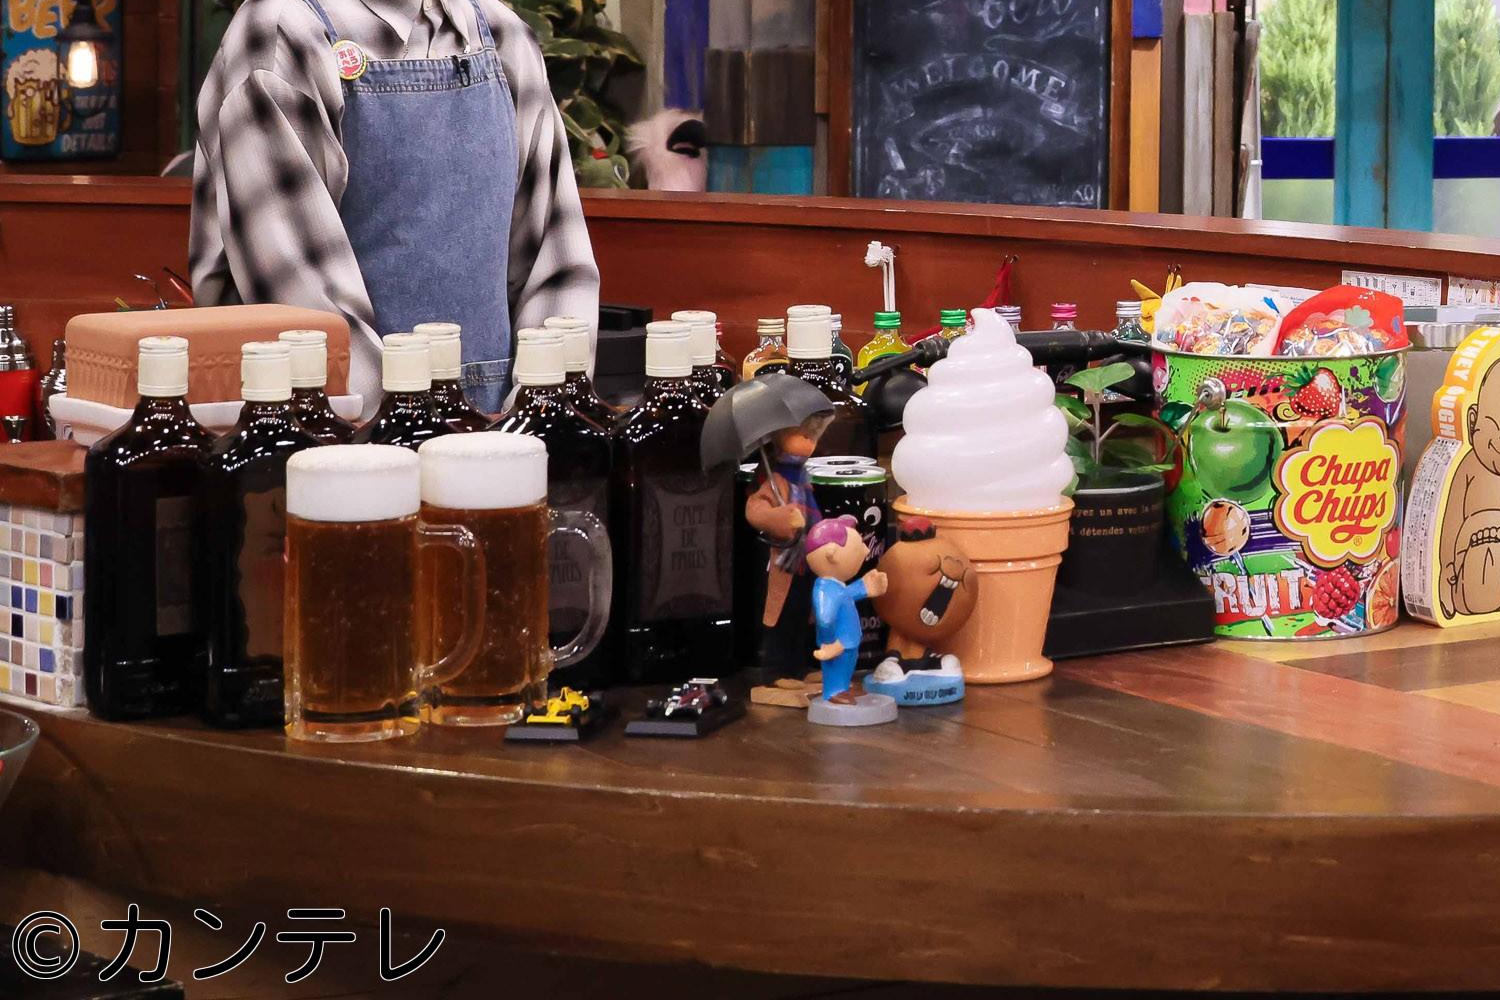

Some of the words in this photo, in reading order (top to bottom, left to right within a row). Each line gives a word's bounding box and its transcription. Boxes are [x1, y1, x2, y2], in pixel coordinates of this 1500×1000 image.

[1452, 338, 1491, 382] THEY
[1300, 454, 1391, 494] Chupa
[1293, 488, 1388, 544] Chups
